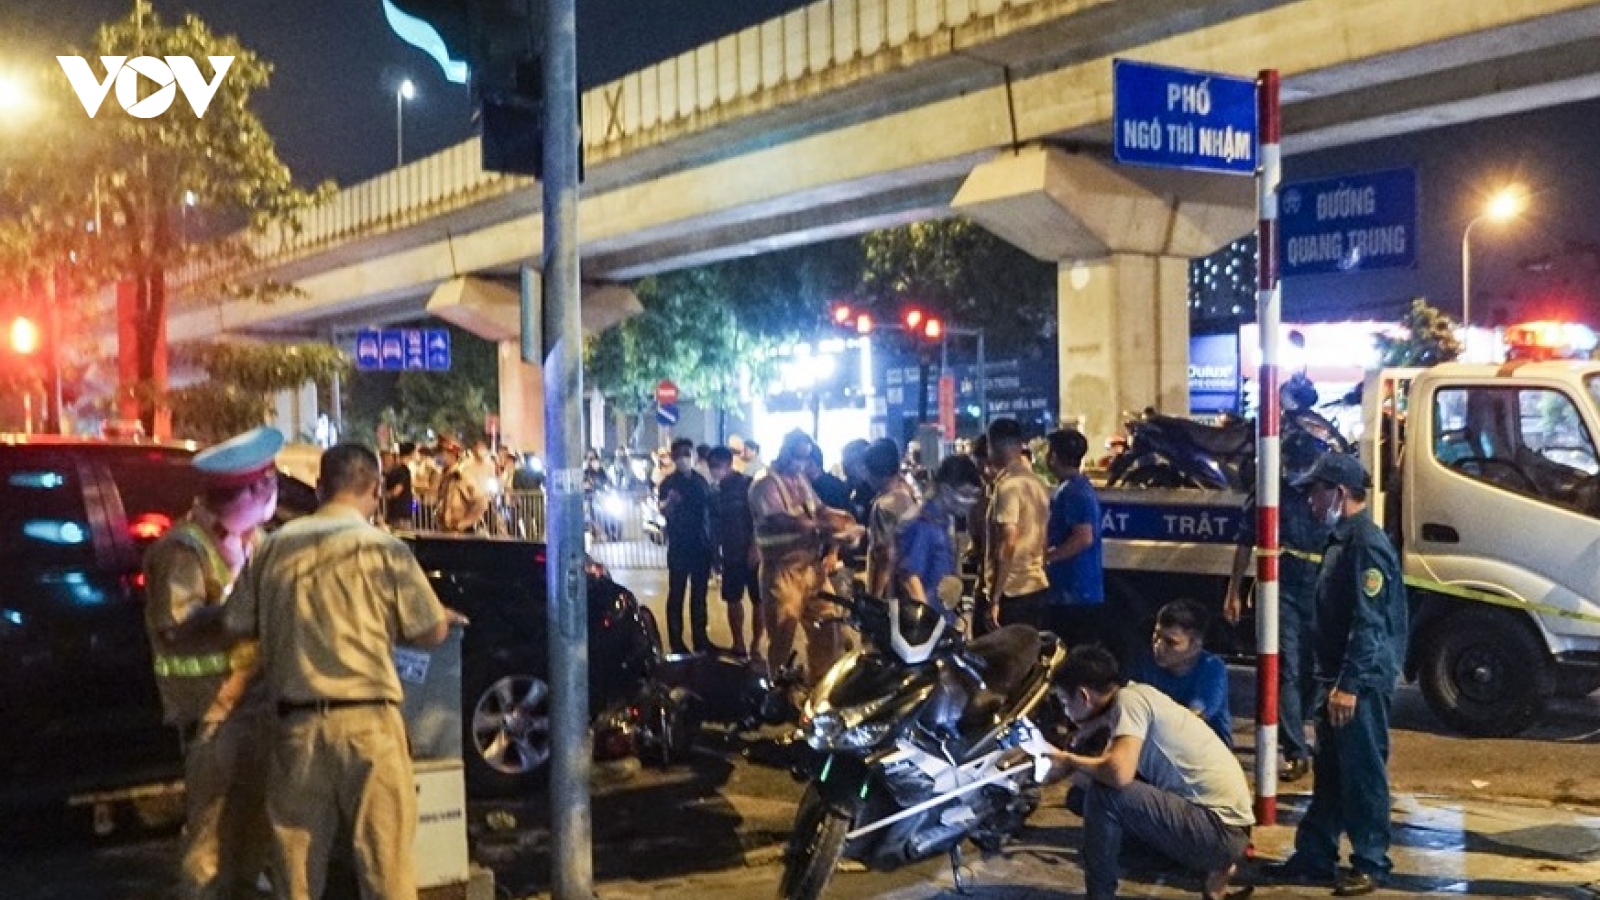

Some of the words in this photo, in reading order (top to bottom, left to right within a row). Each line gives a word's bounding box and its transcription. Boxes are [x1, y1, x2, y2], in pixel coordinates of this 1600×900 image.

[1167, 77, 1211, 115] PHỐ
[1199, 124, 1251, 164] NHẬM
[1288, 232, 1343, 267] QUANG
[1346, 225, 1406, 258] TRUNG
[1101, 509, 1130, 532] ÁT
[1163, 511, 1229, 539] TRẬT
